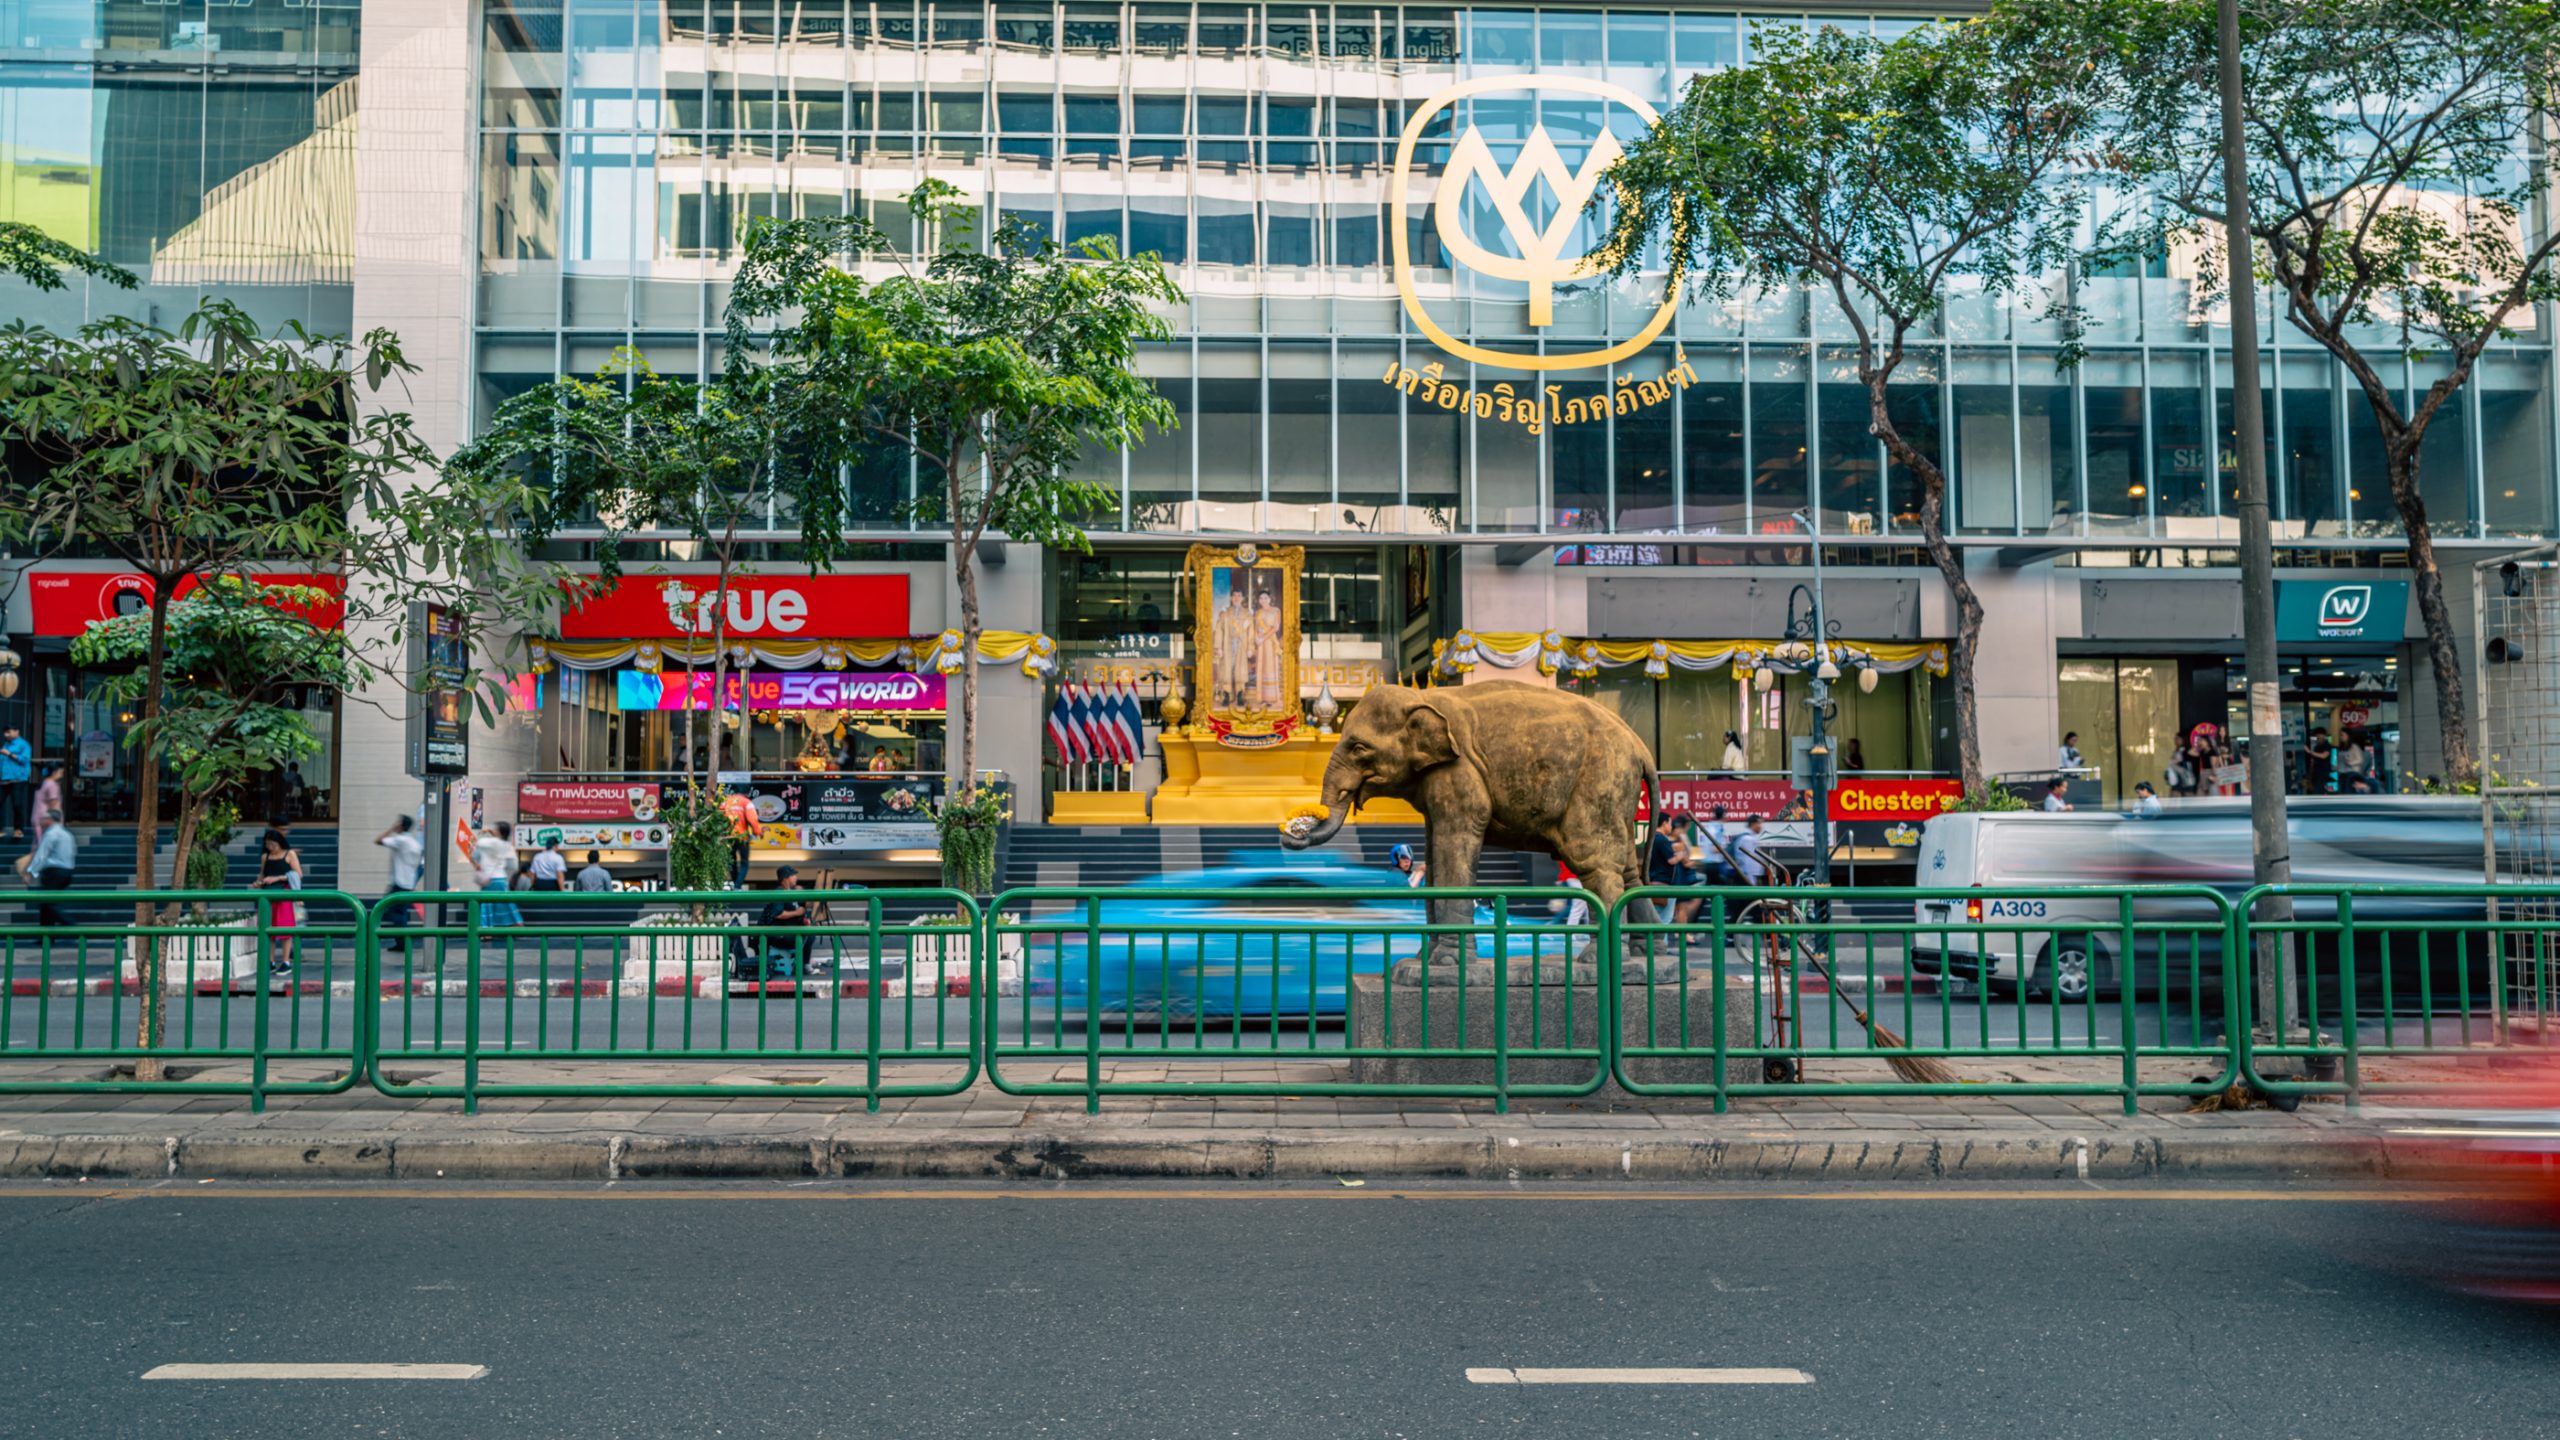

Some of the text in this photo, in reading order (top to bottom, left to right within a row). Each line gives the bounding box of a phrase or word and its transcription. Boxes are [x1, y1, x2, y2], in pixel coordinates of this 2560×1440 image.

[1382, 345, 1700, 435] เครือเจริญโภคภัณฑ์
[117, 578, 141, 589] true
[662, 580, 808, 633] true
[728, 672, 918, 705] true 5G WORLD
[550, 785, 624, 799] กาแฟมวลชน
[1695, 791, 1787, 800] TOKYO BOWLS &
[1695, 801, 1749, 809] NOODLES
[1840, 790, 1953, 811] Chester's
[1990, 901, 2046, 917] A303
